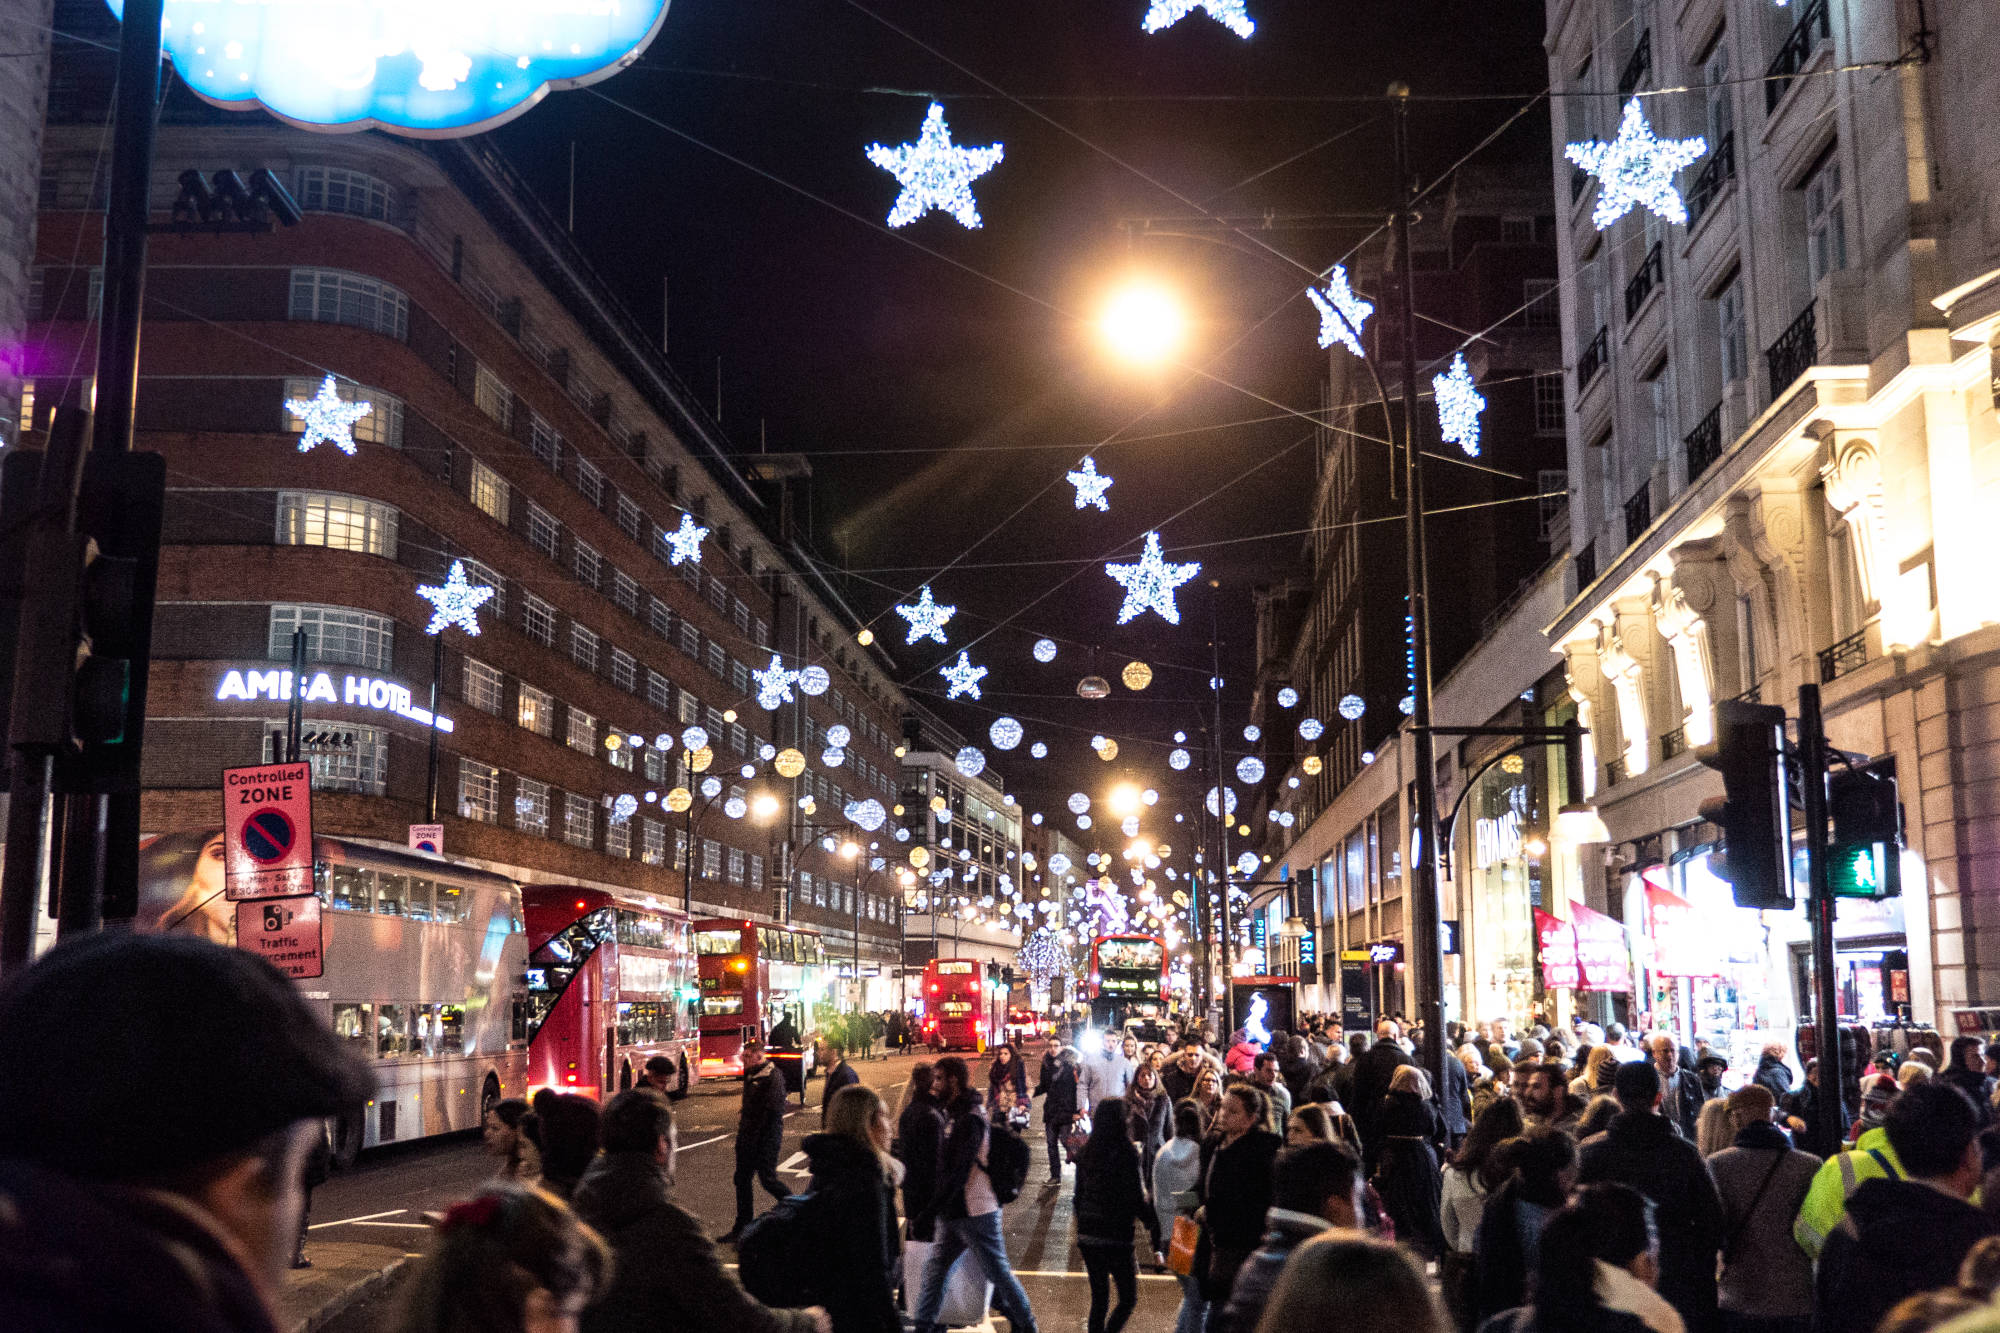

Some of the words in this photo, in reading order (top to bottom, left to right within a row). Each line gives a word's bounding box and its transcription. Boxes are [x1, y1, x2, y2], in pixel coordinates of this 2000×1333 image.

[228, 768, 304, 785] Controlled
[240, 786, 293, 804] ZONE
[260, 938, 299, 949] Traffic
[265, 949, 318, 961] rcement
[1143, 979, 1157, 992] 94
